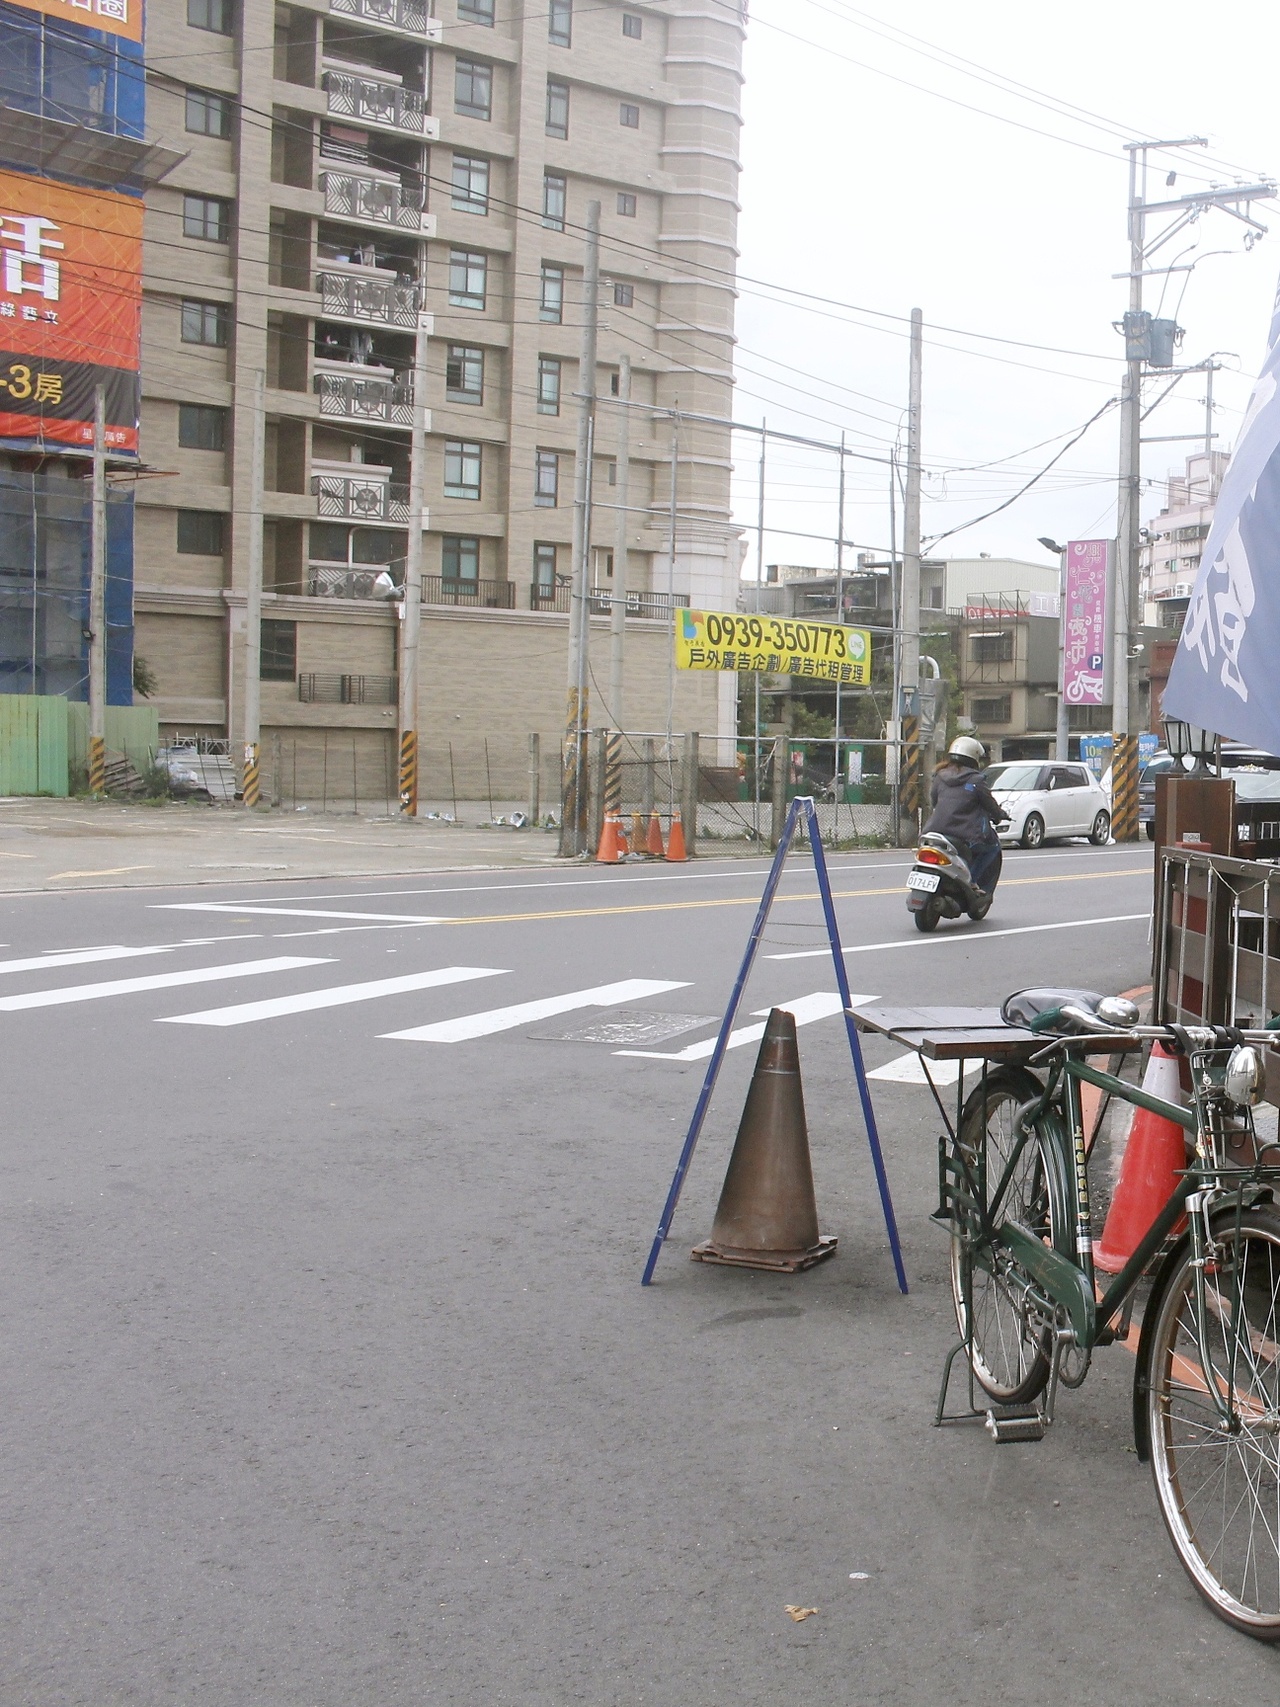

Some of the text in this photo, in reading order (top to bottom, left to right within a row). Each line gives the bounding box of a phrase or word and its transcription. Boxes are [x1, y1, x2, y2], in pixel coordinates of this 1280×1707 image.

[82, 427, 127, 443] 星廣告
[707, 614, 846, 658] 0939-350773
[689, 648, 864, 683] 戶外廣告企劃/廣告代租管理
